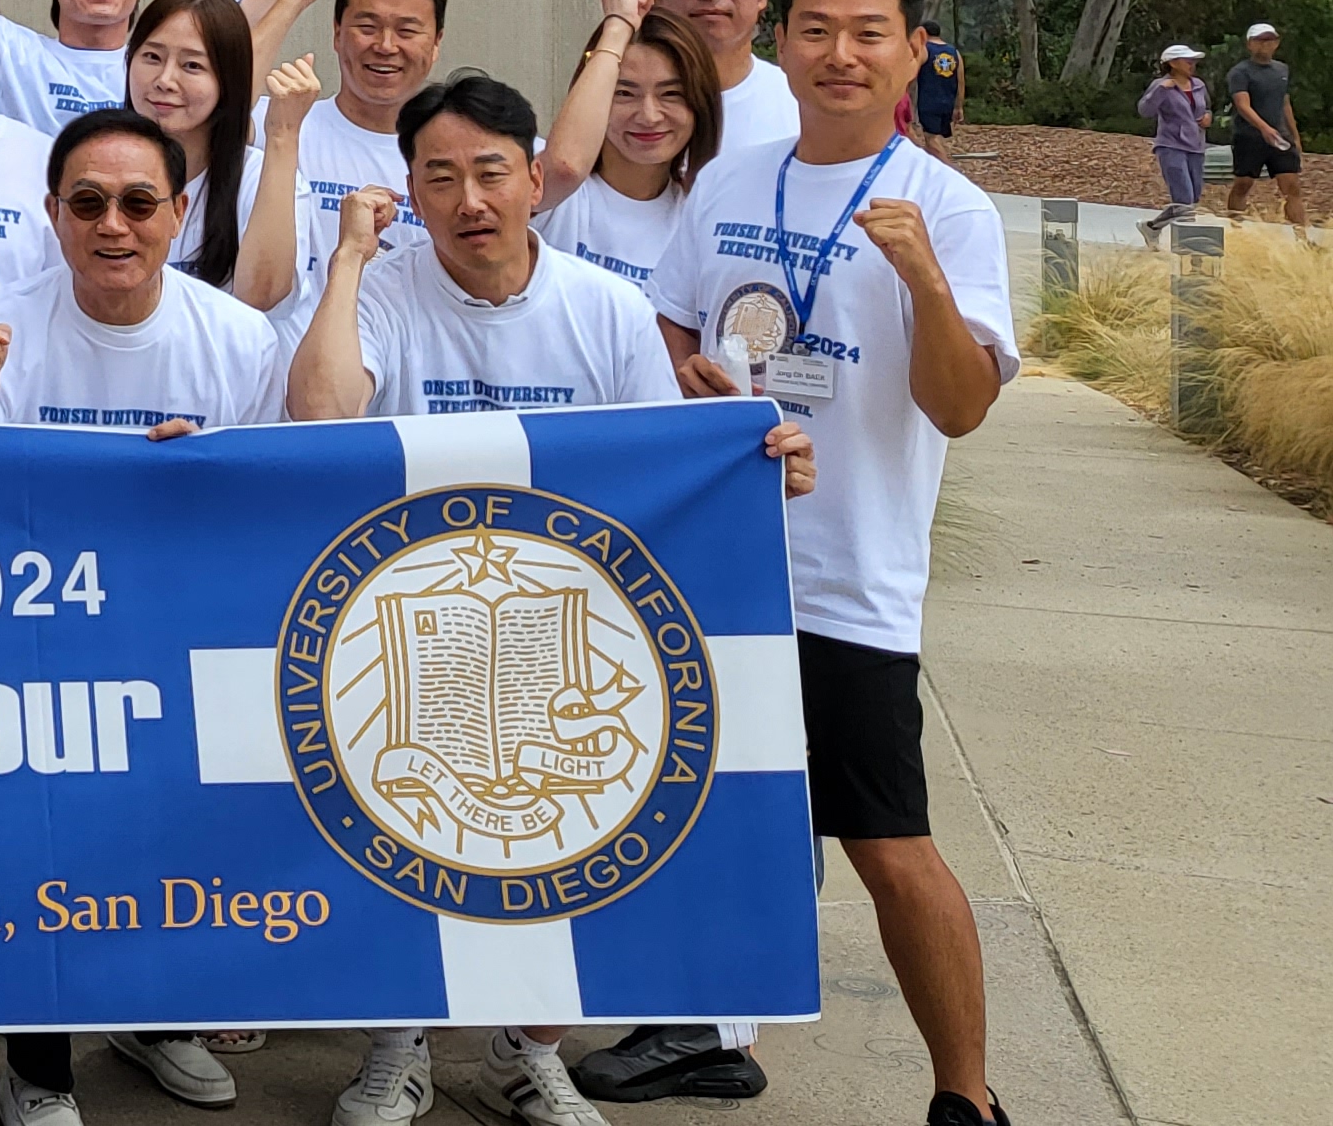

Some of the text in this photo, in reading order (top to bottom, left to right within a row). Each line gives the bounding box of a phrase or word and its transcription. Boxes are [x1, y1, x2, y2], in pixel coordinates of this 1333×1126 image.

[713, 222, 763, 241] YONSEI
[805, 334, 861, 364] 2024
[39, 406, 98, 424] YONSEI
[287, 496, 707, 795] UNIVERSITY OF CALIFORNIA
[407, 750, 606, 833] LET THERE BE LIGHT
[365, 832, 650, 913] SAN DIEGO
[36, 880, 142, 933] San
[160, 878, 331, 944] Diego
